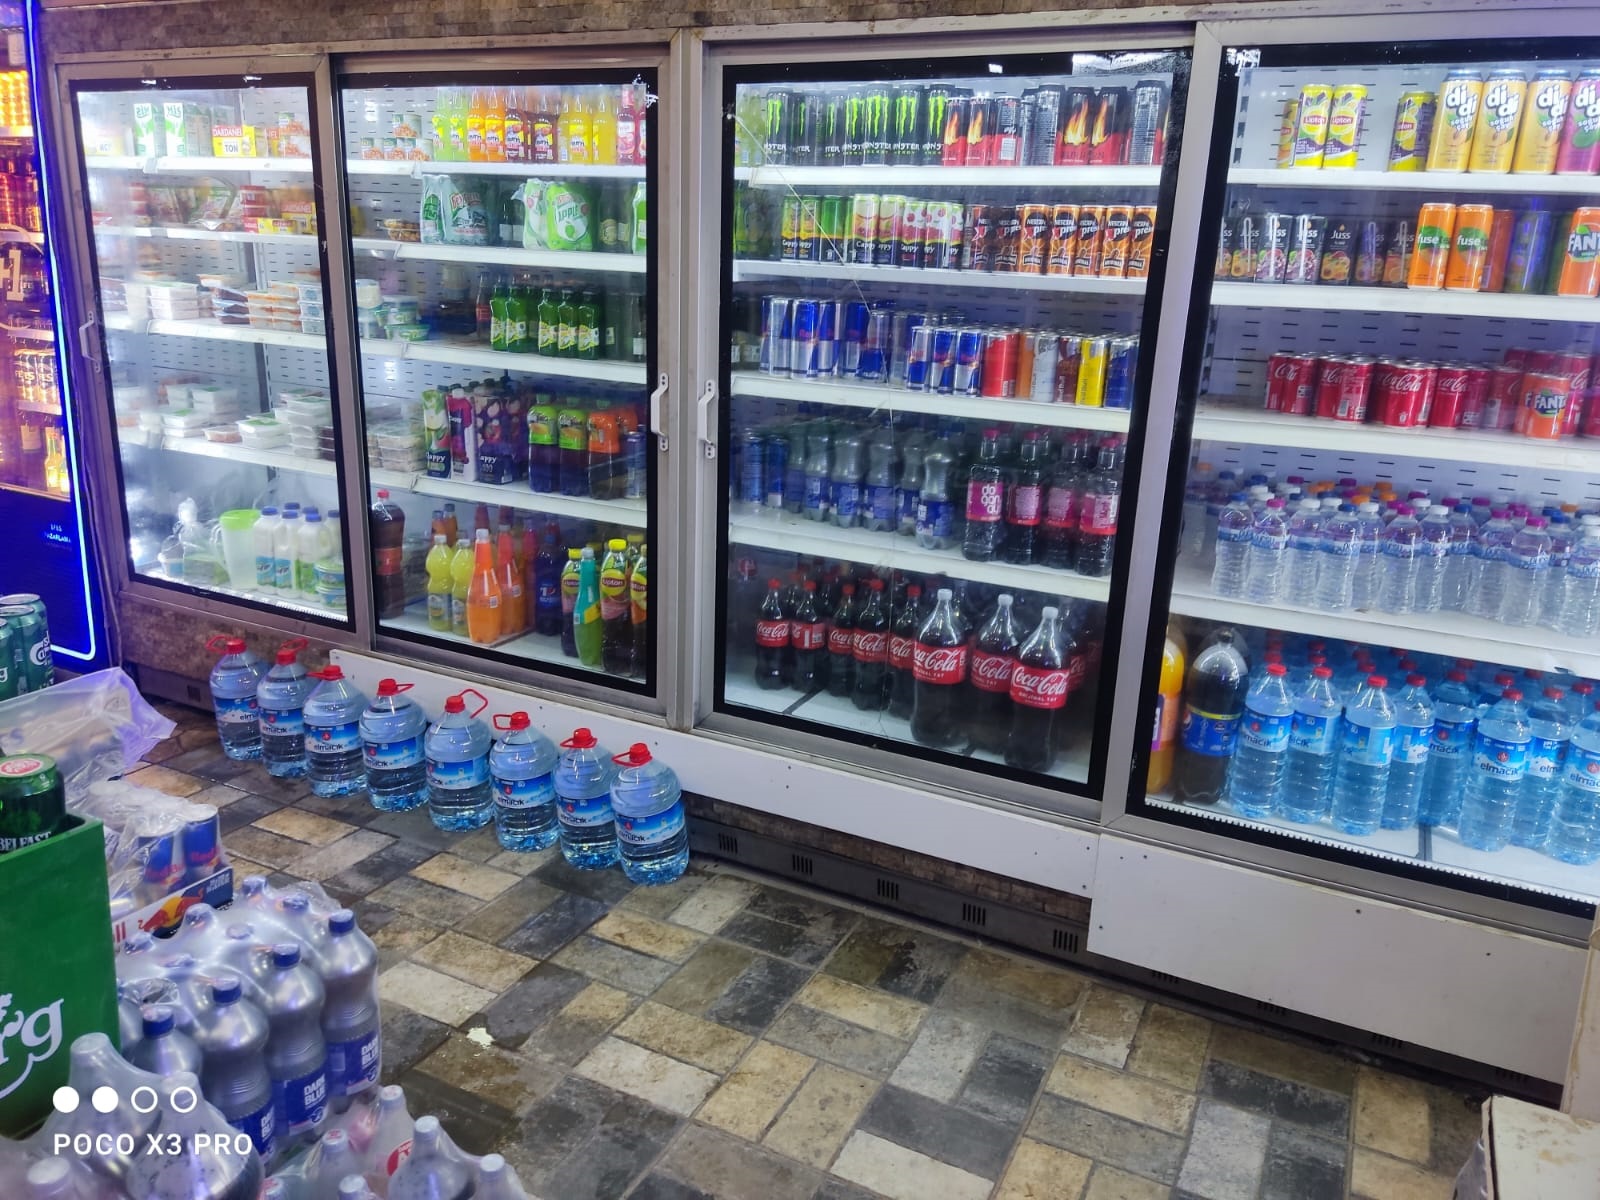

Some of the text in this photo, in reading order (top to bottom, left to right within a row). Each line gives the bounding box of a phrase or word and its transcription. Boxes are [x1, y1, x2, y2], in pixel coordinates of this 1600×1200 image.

[1304, 116, 1326, 124] Lipton
[1331, 230, 1351, 240] Juss
[1418, 233, 1439, 244] fuse
[1457, 234, 1481, 246] fuse
[1011, 665, 1069, 695] Coca-Cola
